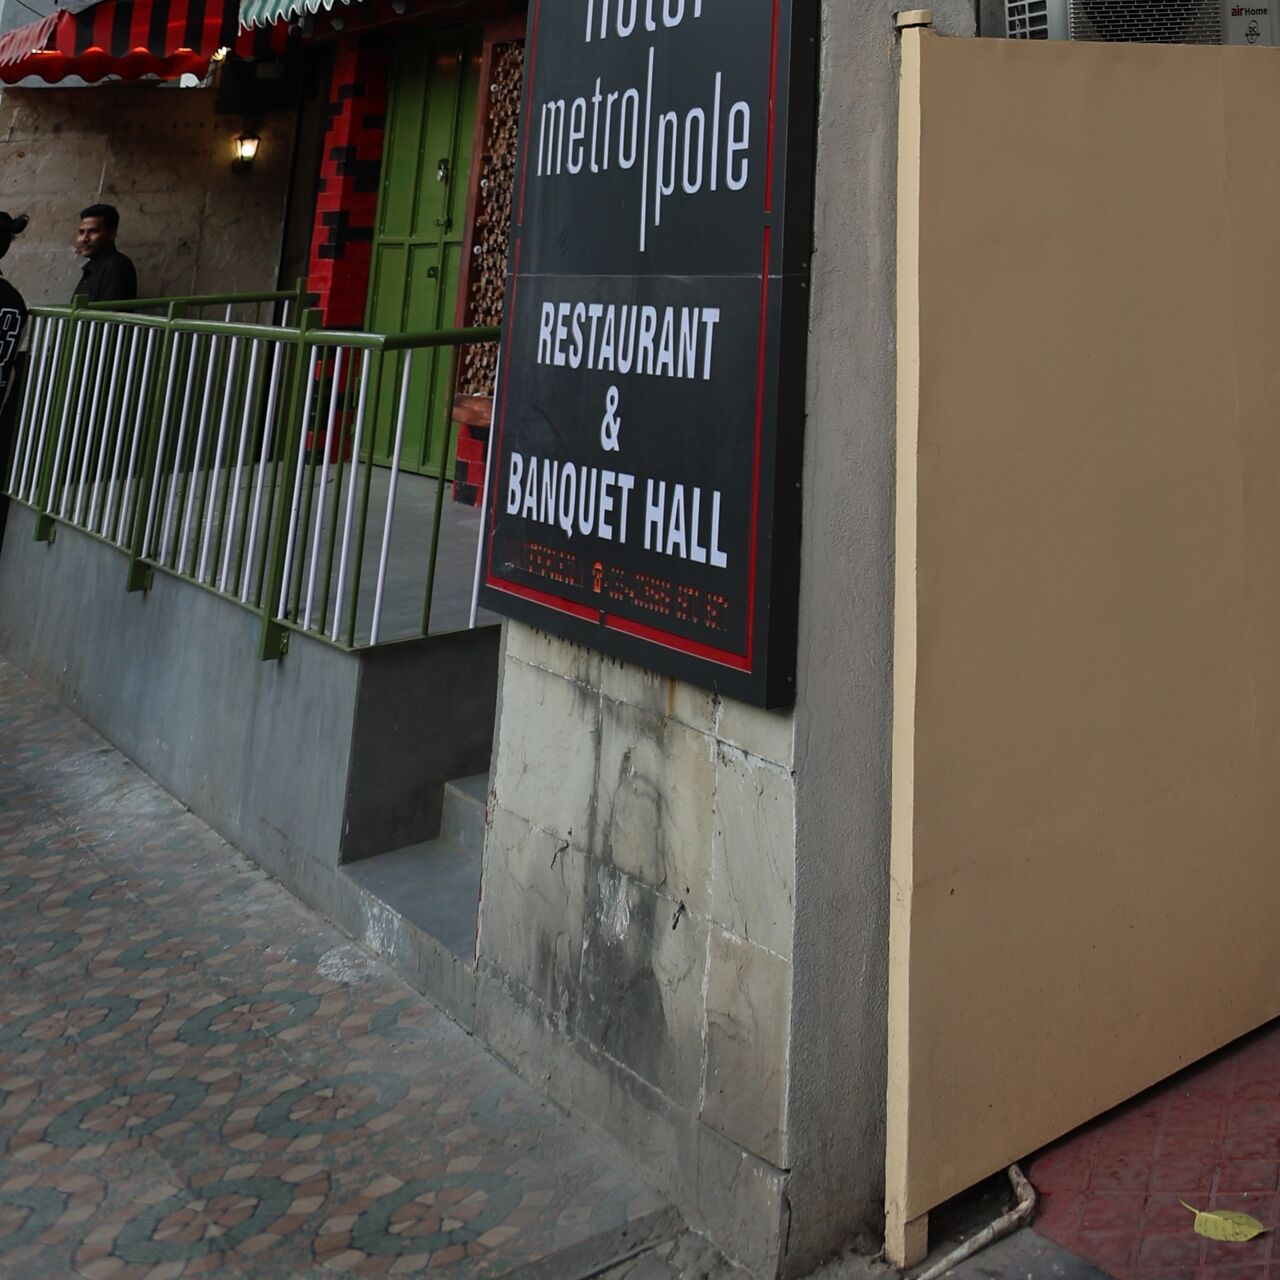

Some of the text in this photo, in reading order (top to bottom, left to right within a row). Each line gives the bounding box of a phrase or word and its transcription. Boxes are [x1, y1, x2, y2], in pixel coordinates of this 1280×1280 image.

[537, 301, 720, 381] RESTAURANT
[600, 385, 621, 452] &
[507, 450, 634, 540] BANQUET
[644, 479, 728, 569] HALL
